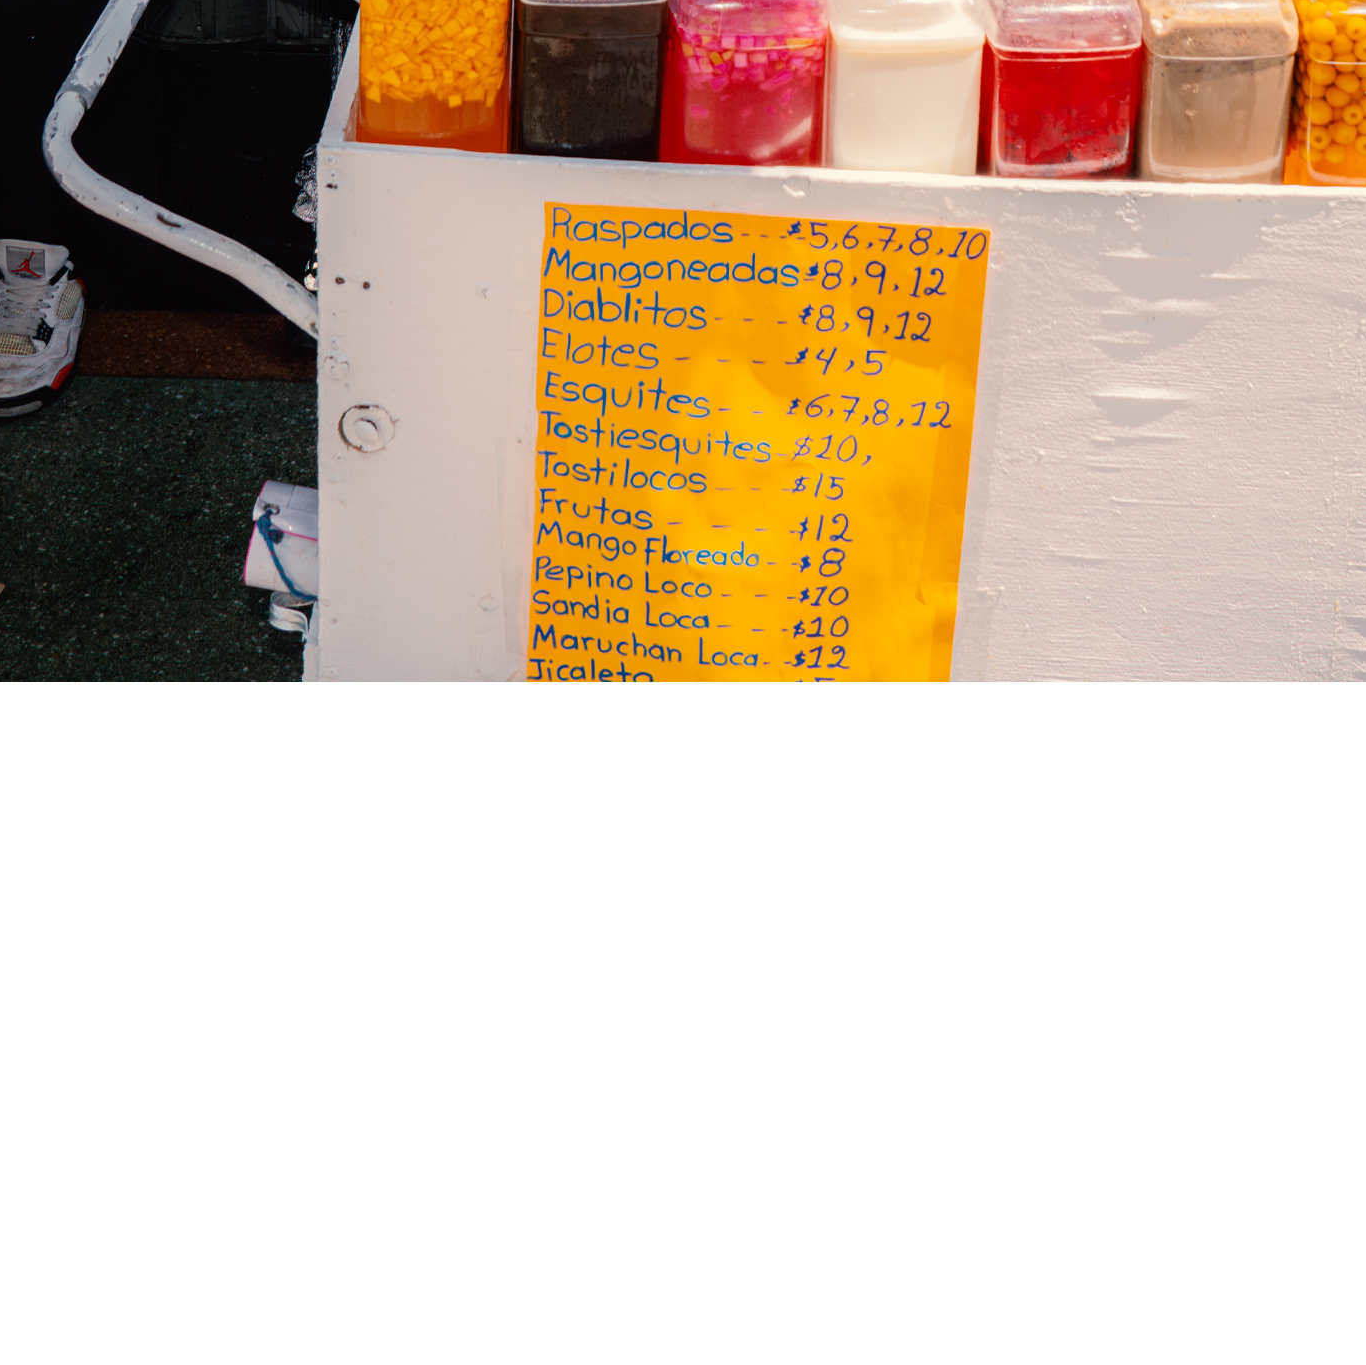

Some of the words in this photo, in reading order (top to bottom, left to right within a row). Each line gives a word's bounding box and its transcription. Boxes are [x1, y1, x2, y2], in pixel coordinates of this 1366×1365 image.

[552, 207, 733, 249] Raspados
[543, 246, 800, 289] Mangoneadas
[543, 286, 707, 330] Diablitos
[541, 326, 659, 370] Elotes
[544, 370, 711, 418] Esquites
[539, 410, 771, 465] Tostiesquites
[538, 450, 707, 494] Tostilocos
[792, 472, 845, 500] $15
[539, 487, 653, 530] Frutas
[537, 521, 637, 562] Mango
[644, 534, 760, 567] Floreado
[535, 555, 633, 590] Pepino
[645, 570, 713, 598] Loco
[798, 586, 850, 607] $10
[532, 589, 629, 624] Sandia
[645, 601, 710, 629] Loca
[792, 615, 850, 638] $10
[532, 624, 683, 663] Maruchan
[698, 636, 759, 667] Loca
